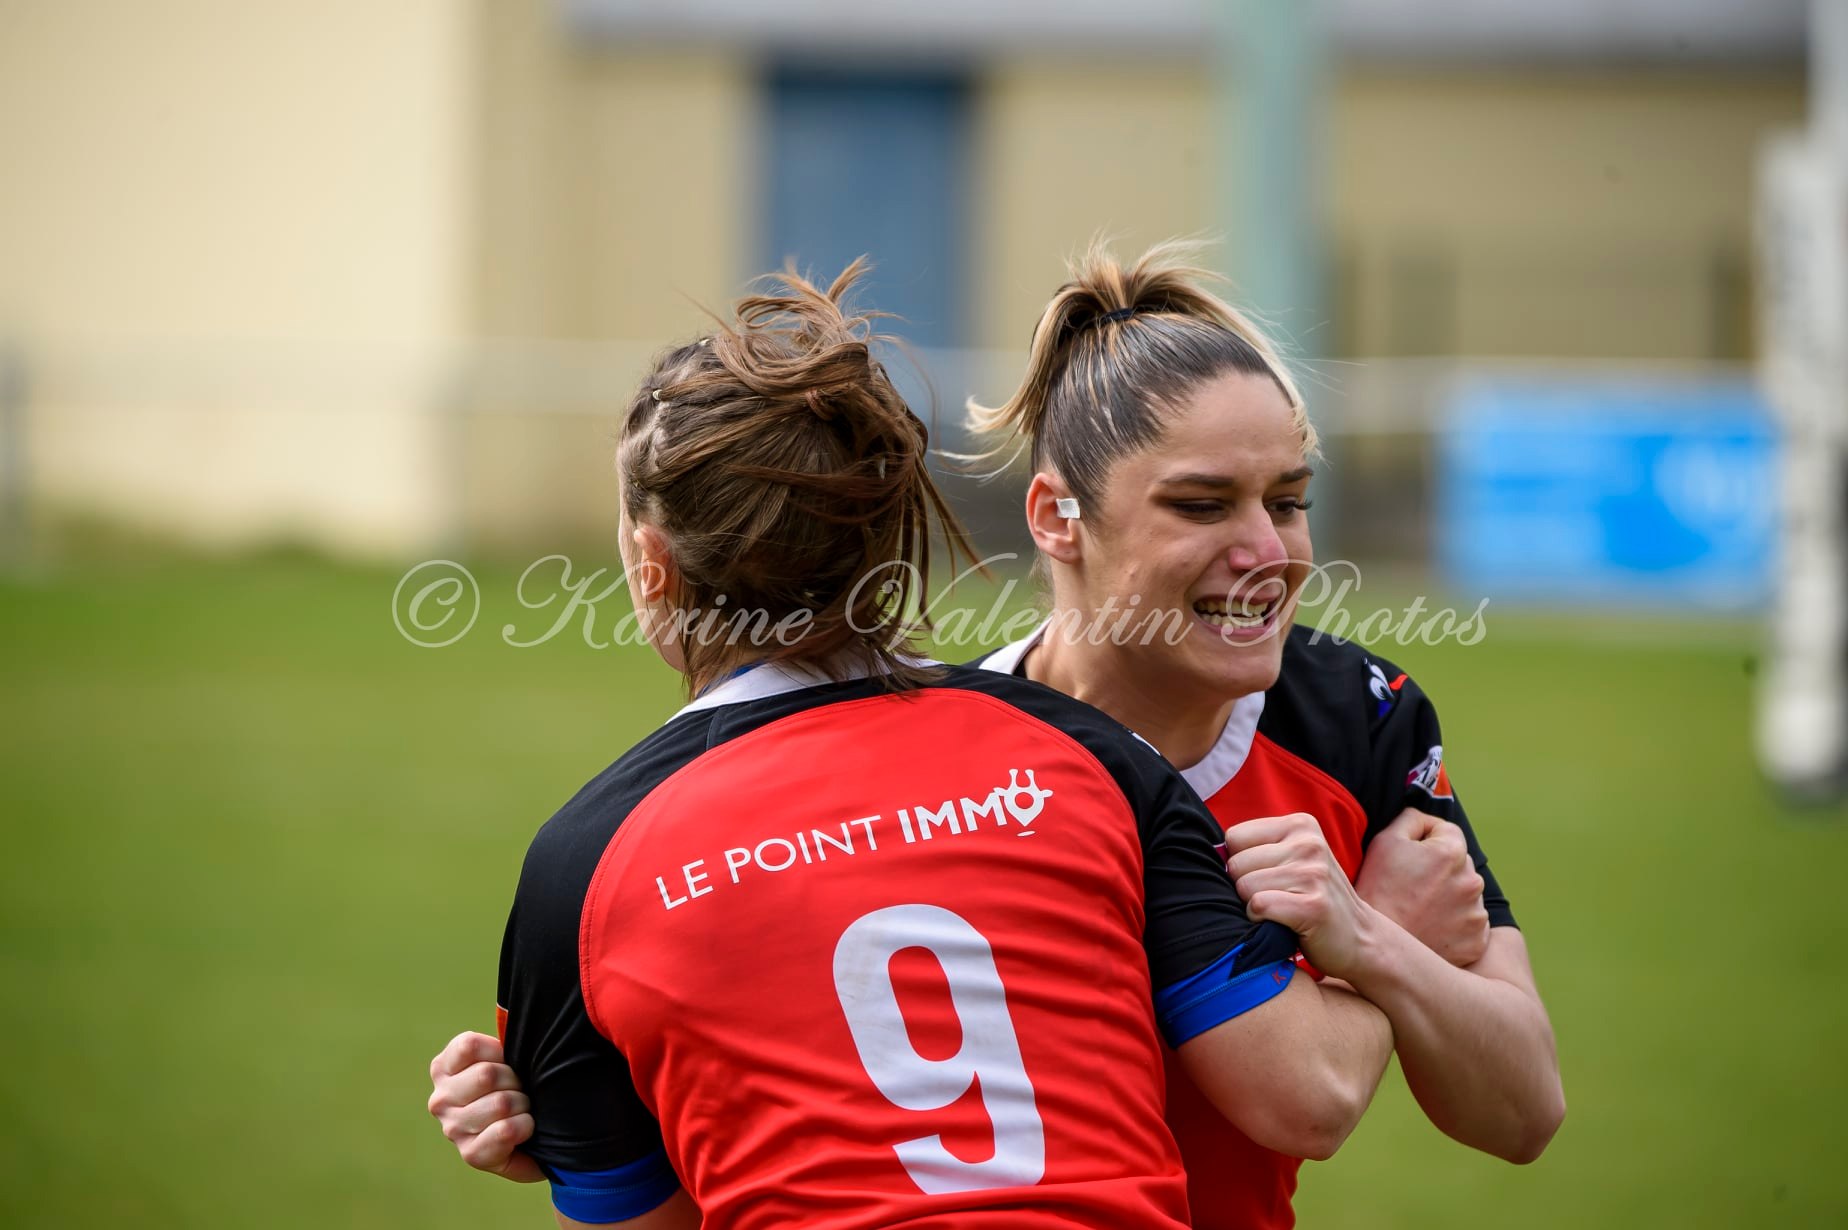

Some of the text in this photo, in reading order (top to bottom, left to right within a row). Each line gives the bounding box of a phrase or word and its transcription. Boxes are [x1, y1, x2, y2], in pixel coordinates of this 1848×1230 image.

[655, 768, 1054, 910] LE POINT IMMO
[832, 903, 1046, 1195] 9
